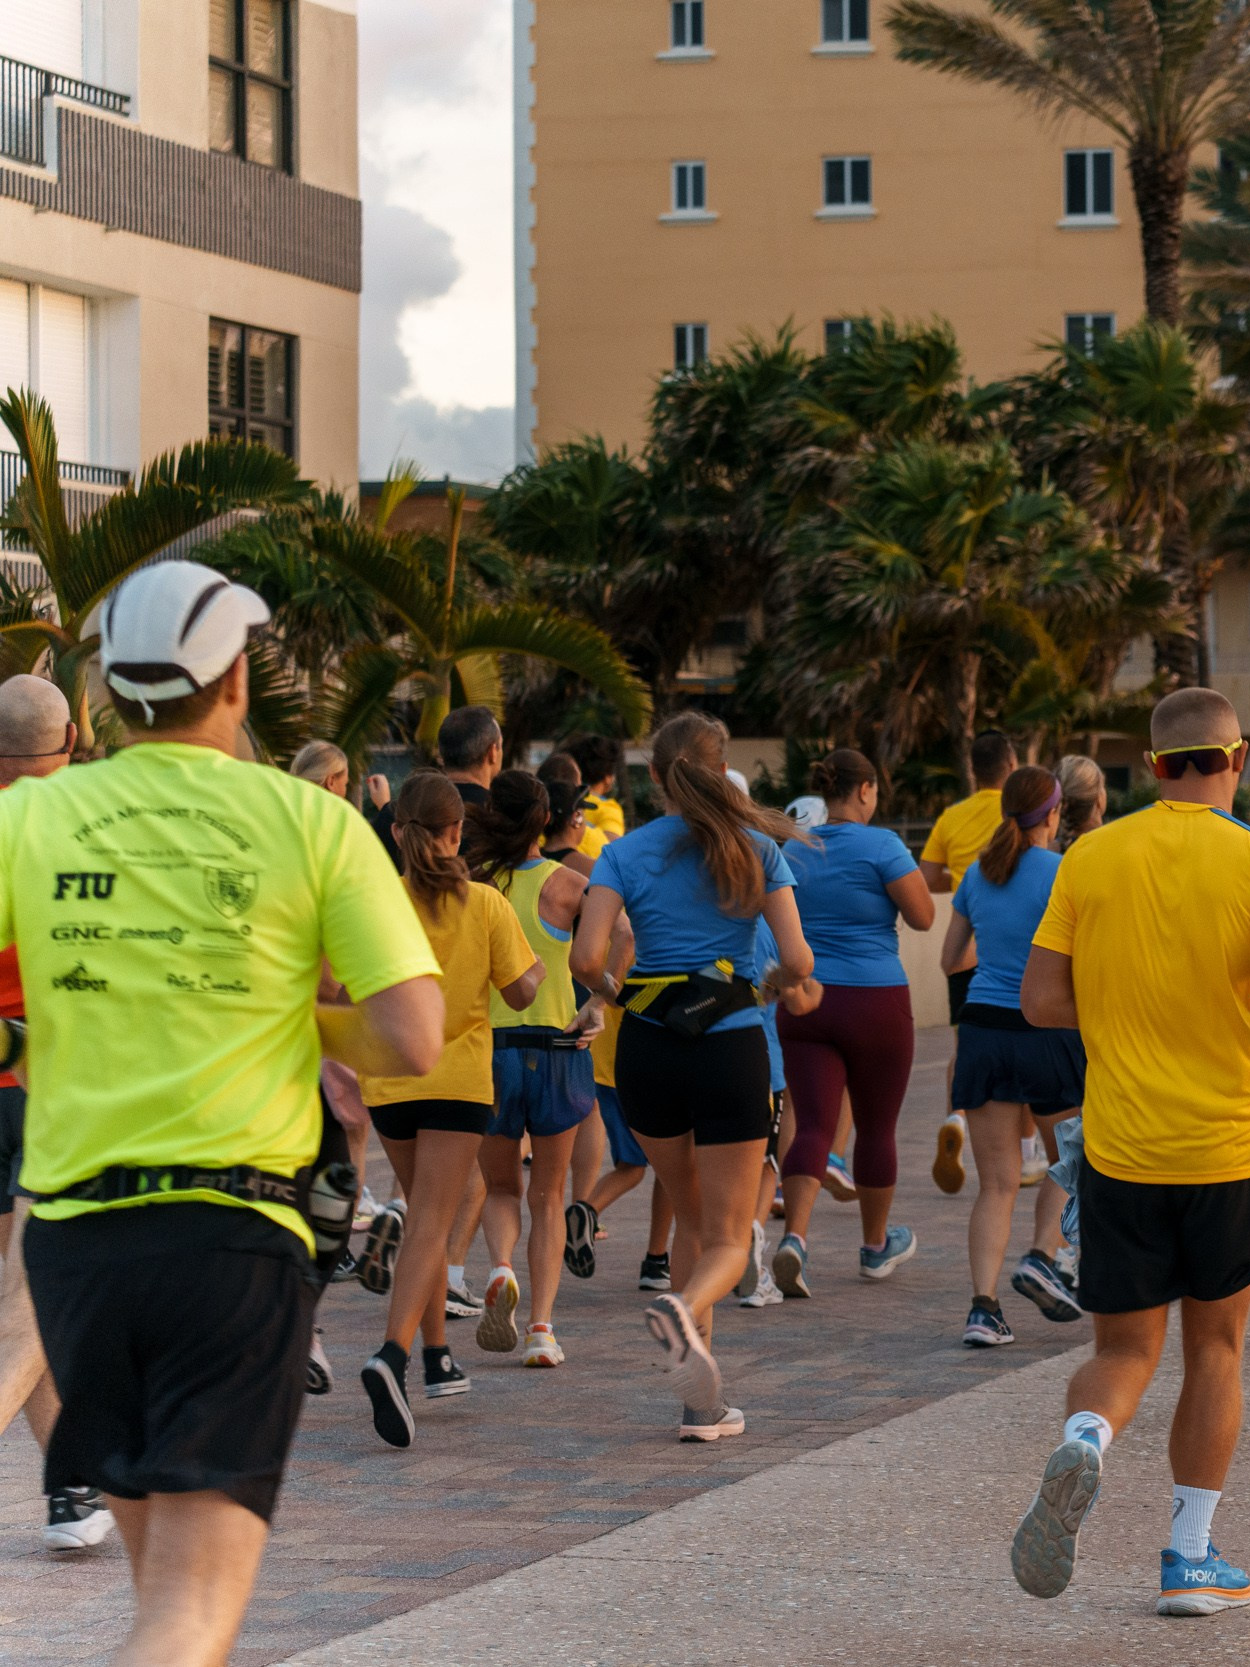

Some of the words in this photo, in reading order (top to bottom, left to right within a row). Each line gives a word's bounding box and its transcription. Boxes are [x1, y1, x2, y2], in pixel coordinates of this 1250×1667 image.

[53, 873, 117, 900] FIU
[51, 927, 112, 941] GNC
[1184, 1568, 1217, 1586] HOKA
